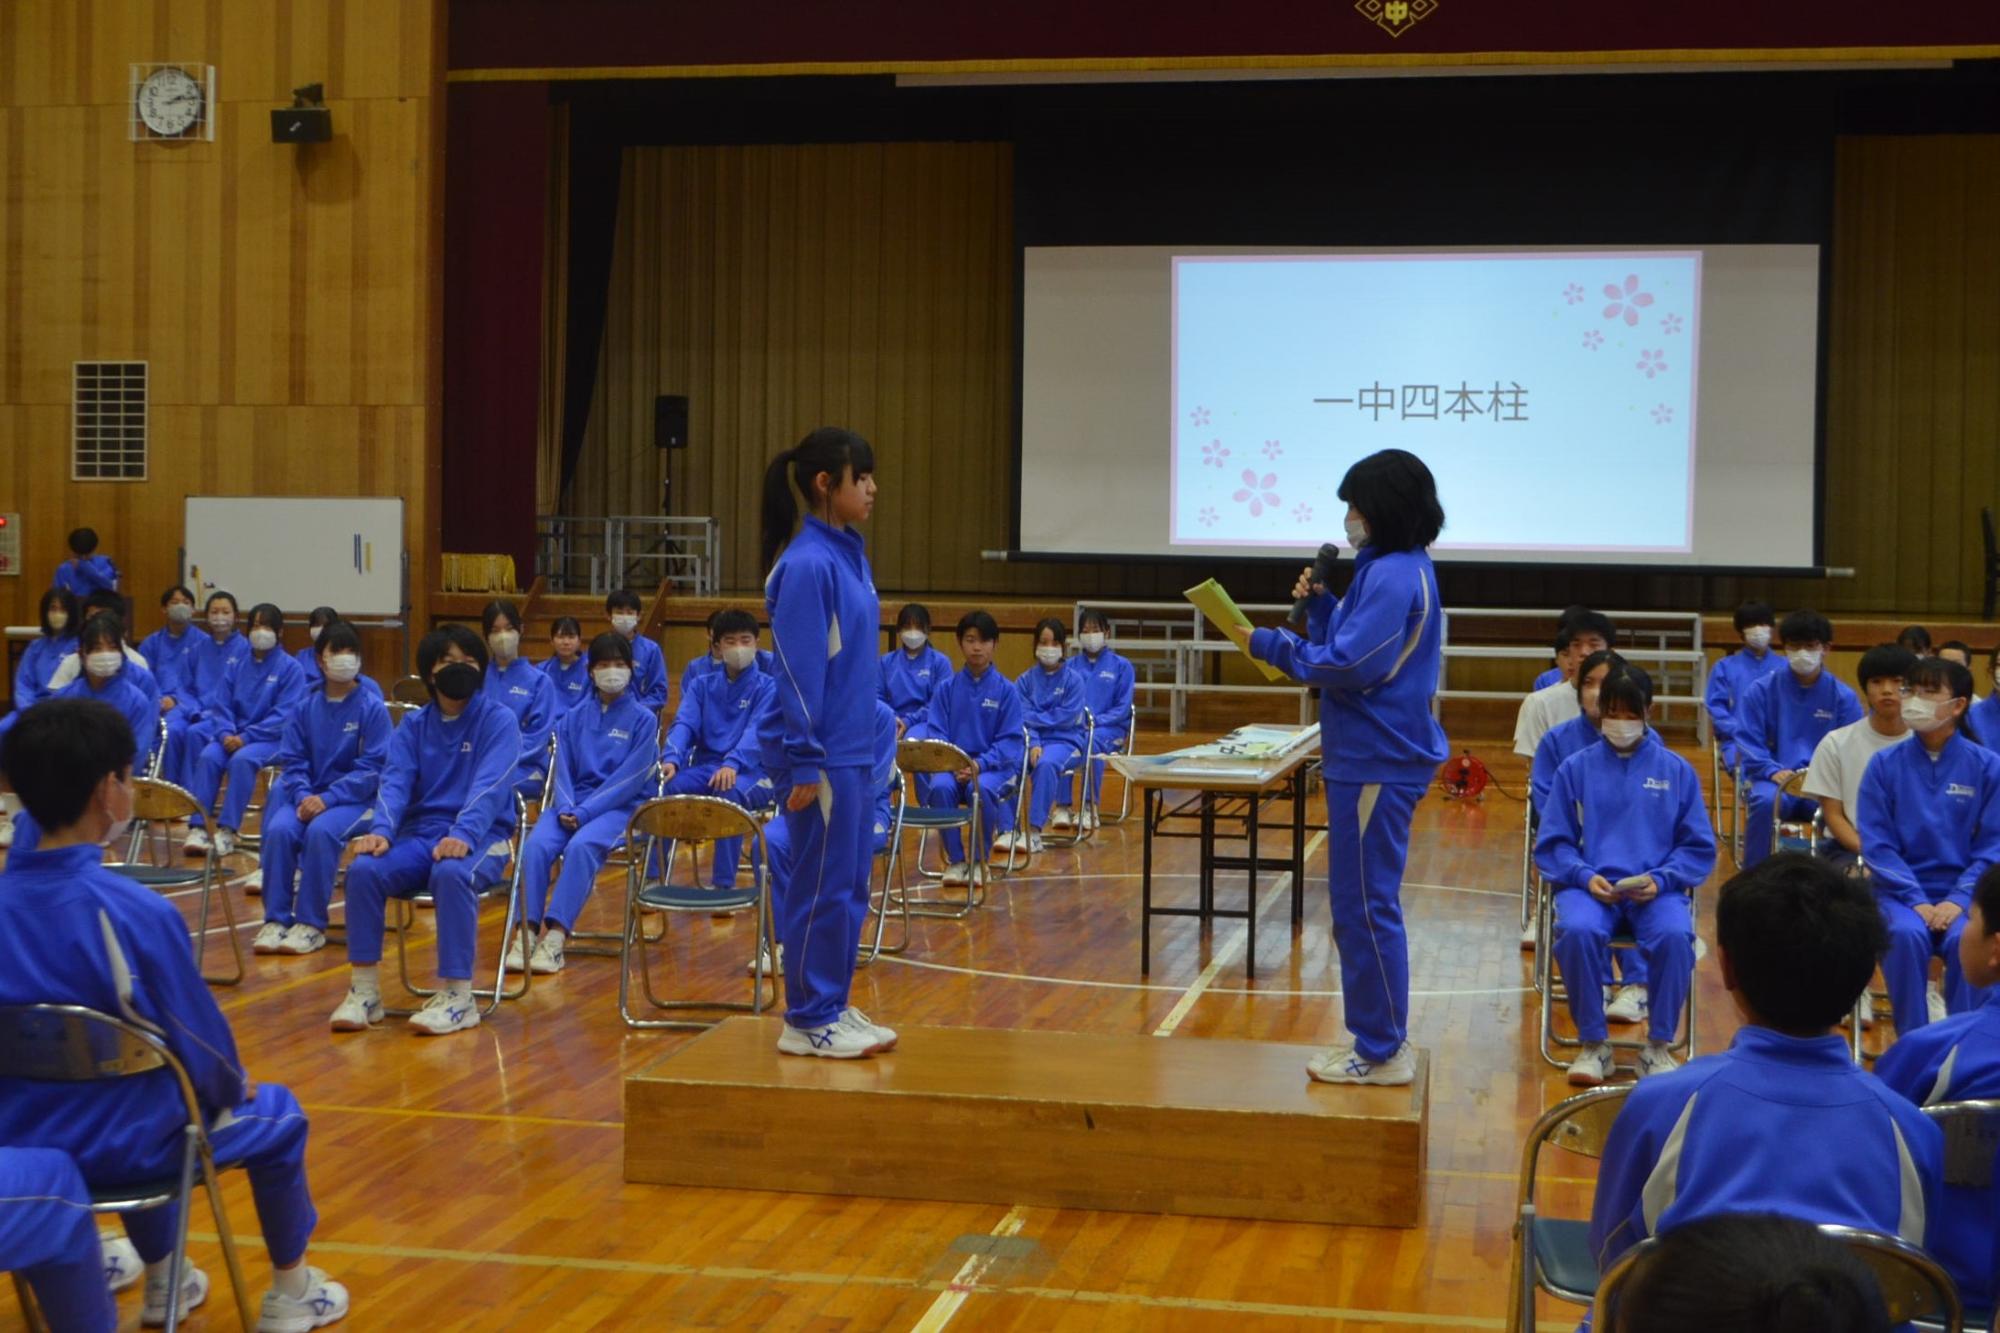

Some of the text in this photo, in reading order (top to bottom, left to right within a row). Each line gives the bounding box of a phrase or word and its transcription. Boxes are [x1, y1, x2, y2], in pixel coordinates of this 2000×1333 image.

[1385, 1, 1409, 26] 中
[1313, 380, 1529, 422] 一中四本柱
